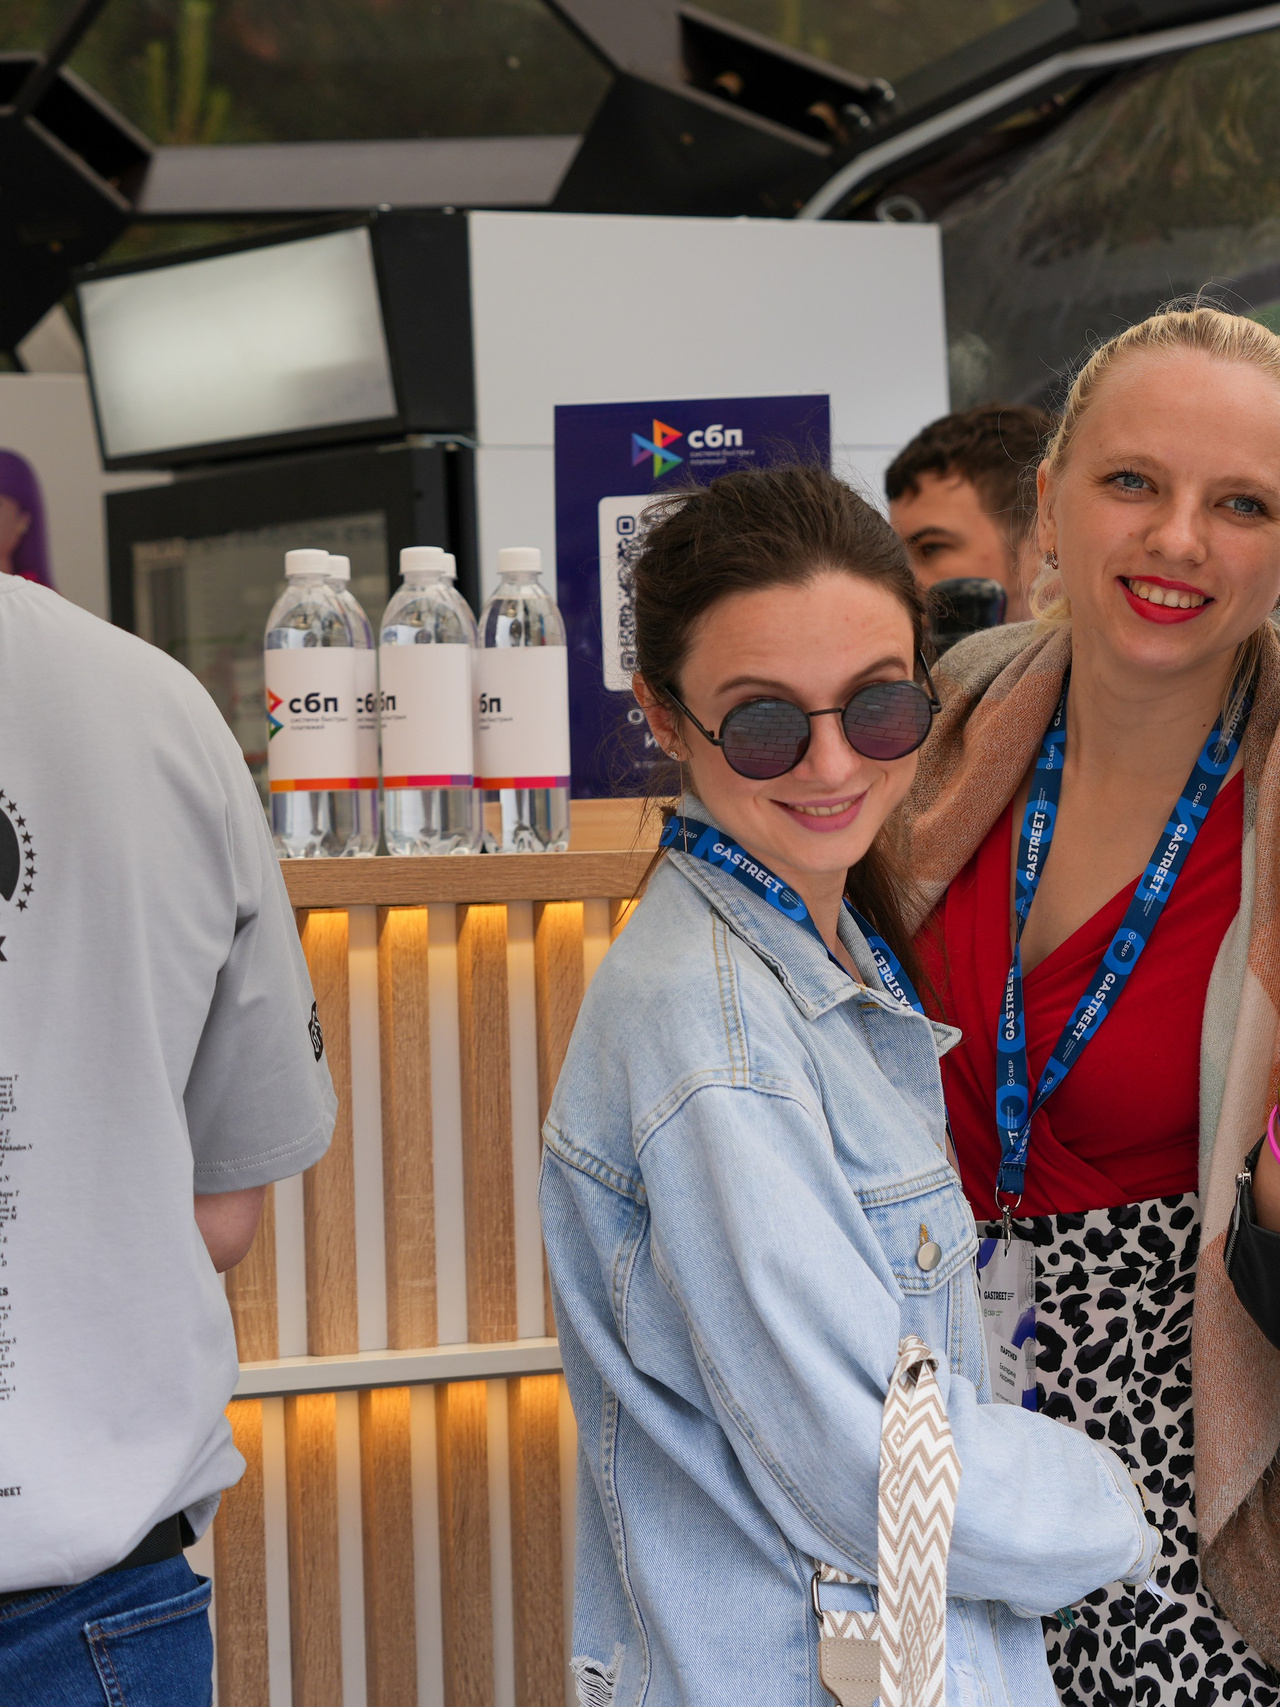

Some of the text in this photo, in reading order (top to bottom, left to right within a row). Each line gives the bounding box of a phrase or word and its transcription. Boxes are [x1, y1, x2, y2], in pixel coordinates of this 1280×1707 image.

[687, 424, 743, 448] сбп
[289, 692, 339, 713] сбп
[712, 842, 784, 894] GASTREET
[1025, 811, 1046, 881] GASTREET
[1149, 823, 1188, 894] GASTREET
[872, 949, 914, 1011] ASTREET
[1072, 972, 1116, 1041] GASTREET
[984, 1291, 1007, 1300] GASTREET
